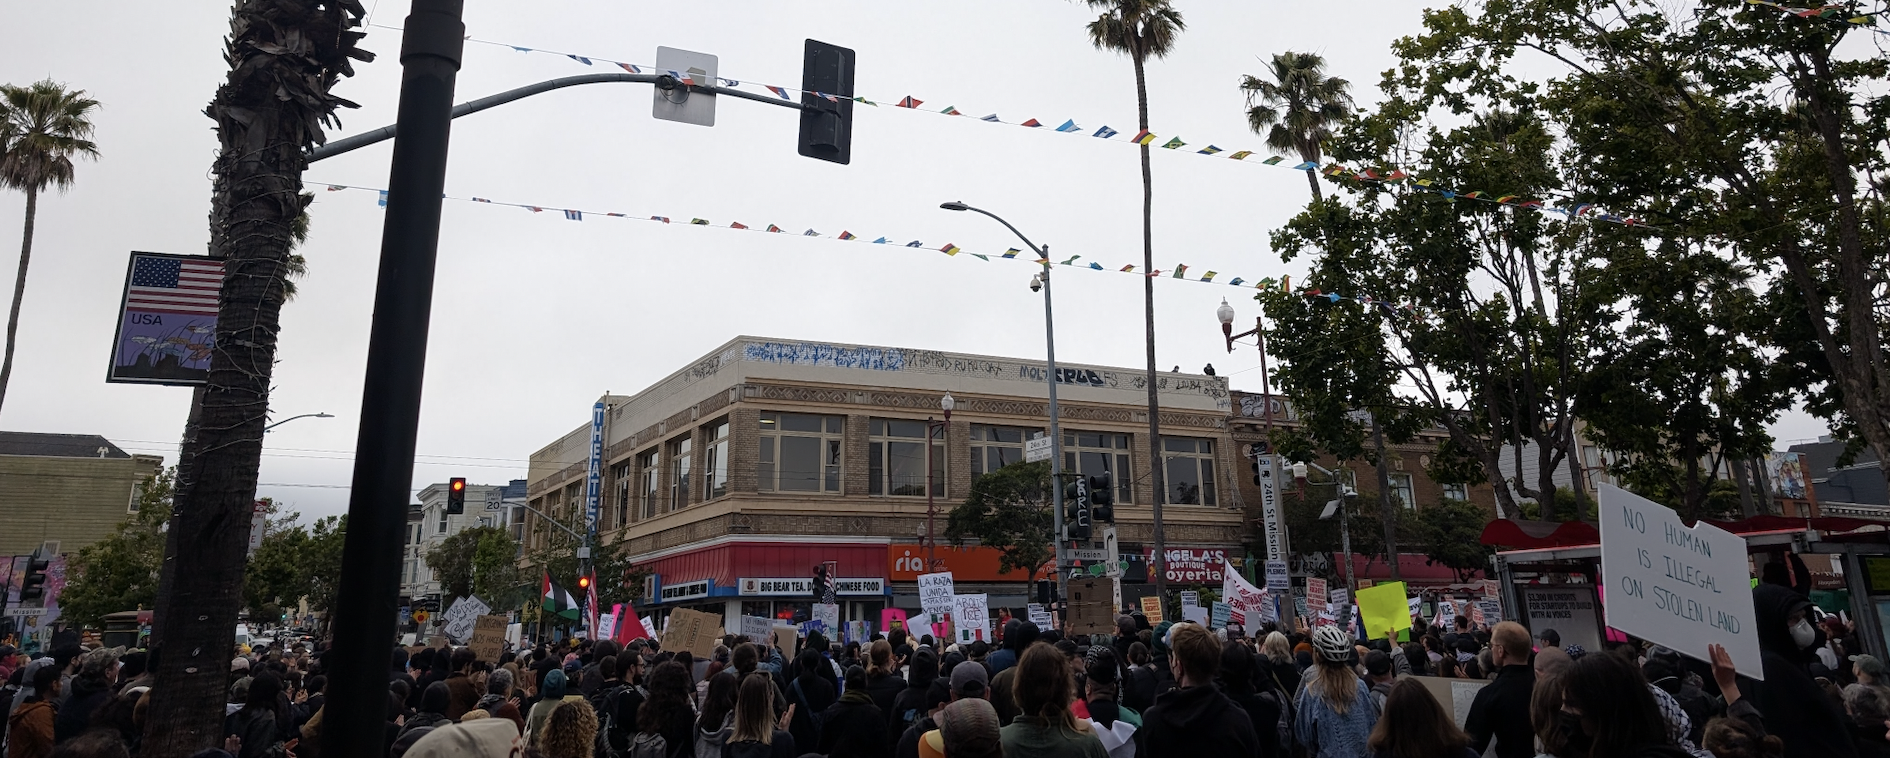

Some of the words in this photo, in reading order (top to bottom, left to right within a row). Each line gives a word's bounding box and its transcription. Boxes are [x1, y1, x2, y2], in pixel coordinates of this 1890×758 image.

[132, 314, 162, 326] USA
[1264, 484, 1274, 506] 24th
[486, 502, 500, 510] 20
[1266, 508, 1276, 519] St
[1624, 506, 1645, 534] NO
[1664, 522, 1712, 558] HUMAN
[1268, 521, 1280, 560] Mission
[896, 550, 923, 572] ria
[1170, 562, 1205, 570] BOUTIQUE
[1165, 568, 1222, 582] oyeria
[1638, 548, 1651, 568] IS
[1664, 555, 1721, 593] ILLEGAL
[760, 582, 772, 592] BIG
[774, 582, 790, 592] BEAR
[836, 582, 861, 592] CHINESE
[863, 582, 880, 592] FOOD
[920, 578, 932, 588] LA
[933, 577, 952, 586] RAZA
[926, 588, 948, 596] UNIDA
[1622, 576, 1643, 599] ON
[1654, 586, 1703, 622] STOLEN
[1708, 606, 1740, 634] LAND
[1553, 610, 1572, 618] VOICES
